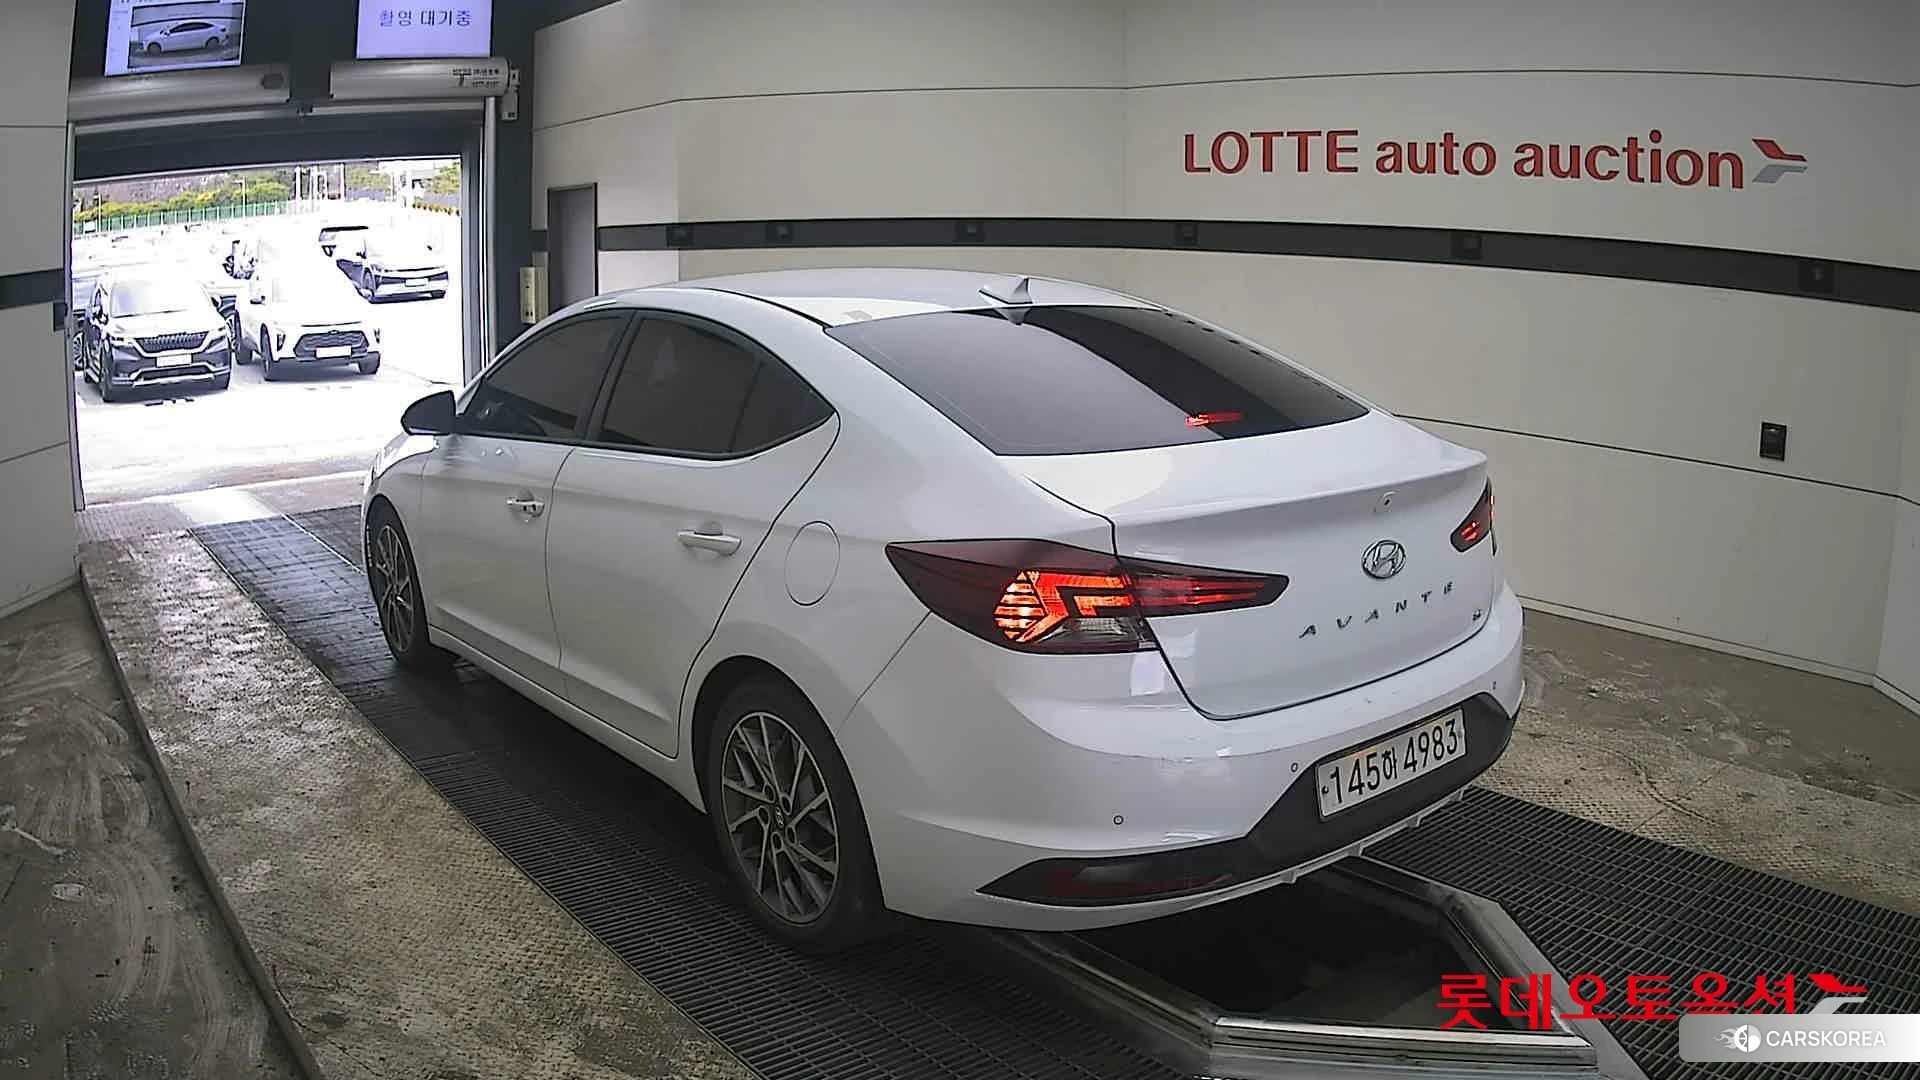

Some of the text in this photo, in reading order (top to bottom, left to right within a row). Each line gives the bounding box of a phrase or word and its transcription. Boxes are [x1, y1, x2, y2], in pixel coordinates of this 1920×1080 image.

[420, 9, 470, 26] 대기중
[1184, 129, 1744, 189] LOTTE auto auction
[1299, 581, 1453, 638] AVANTE
[1330, 718, 1457, 803] 145하 4983
